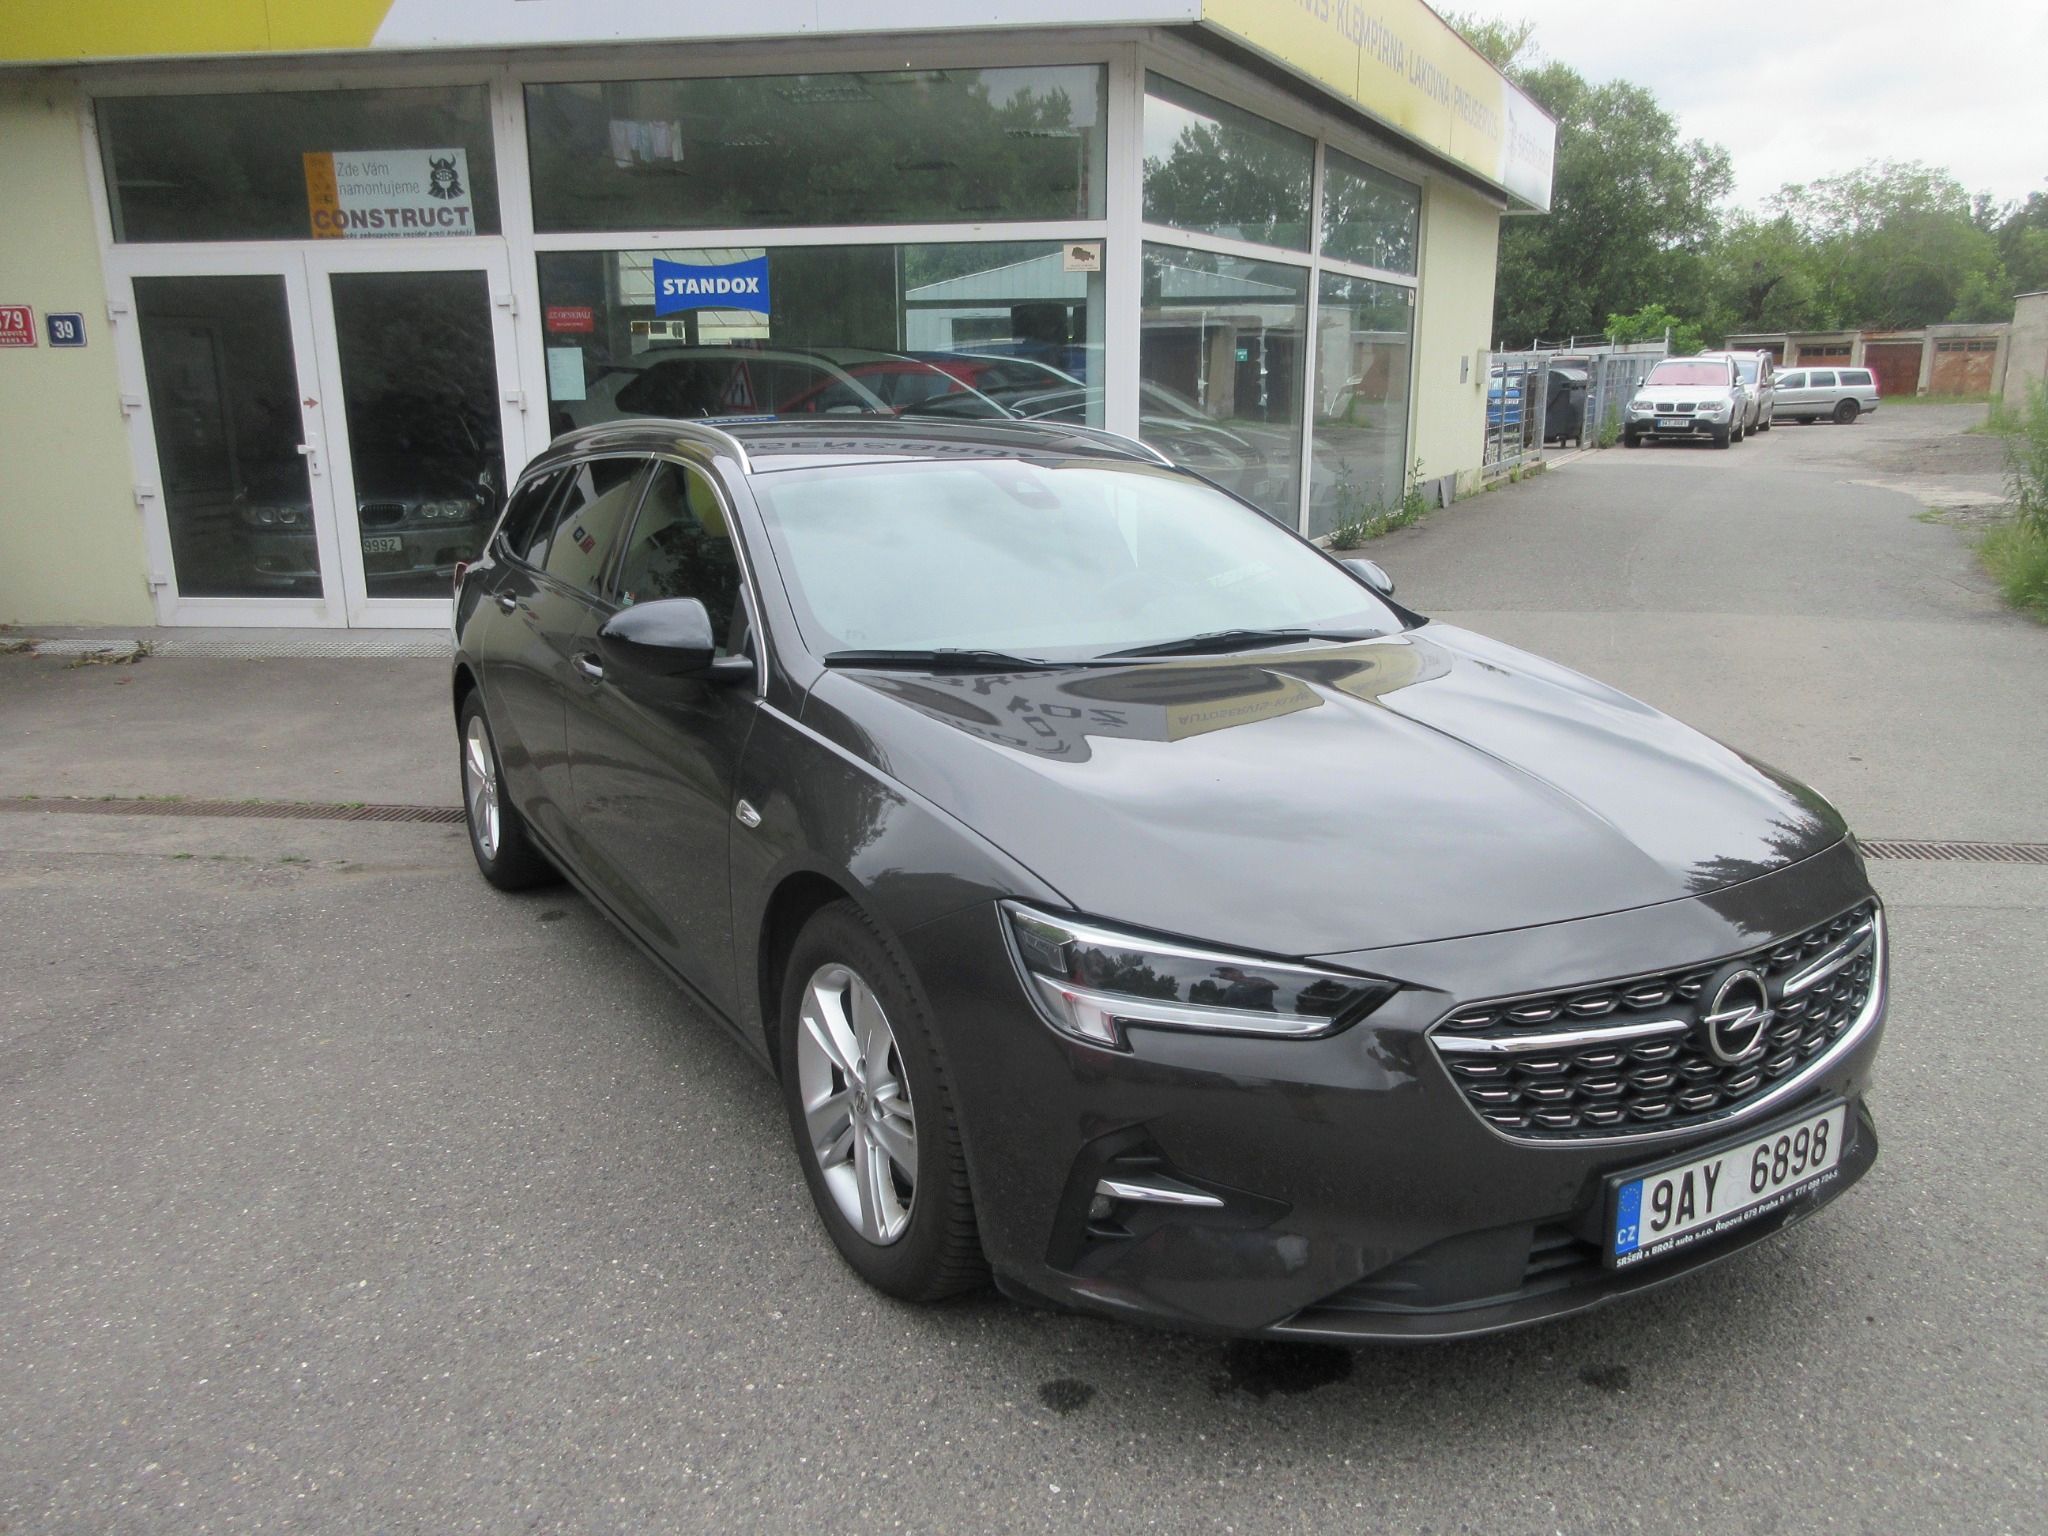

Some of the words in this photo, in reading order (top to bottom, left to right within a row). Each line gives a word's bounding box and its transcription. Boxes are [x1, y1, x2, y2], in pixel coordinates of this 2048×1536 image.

[1336, 0, 1404, 78] KLEMPÍRNA
[1408, 50, 1450, 110] LAKOVNA
[337, 161, 360, 177] Zde
[362, 161, 390, 177] Vám
[339, 181, 420, 197] namontujeme
[314, 206, 470, 230] CONSTRUCT
[663, 277, 760, 296] STANDOX
[0, 310, 24, 330] 79
[55, 320, 75, 339] 39
[1650, 1160, 1722, 1232] 9AY
[1750, 1118, 1829, 1194] 6898
[1675, 1234, 1694, 1247] auto
[1759, 1200, 1779, 1215] Praha
[1617, 1225, 1636, 1245] CZ
